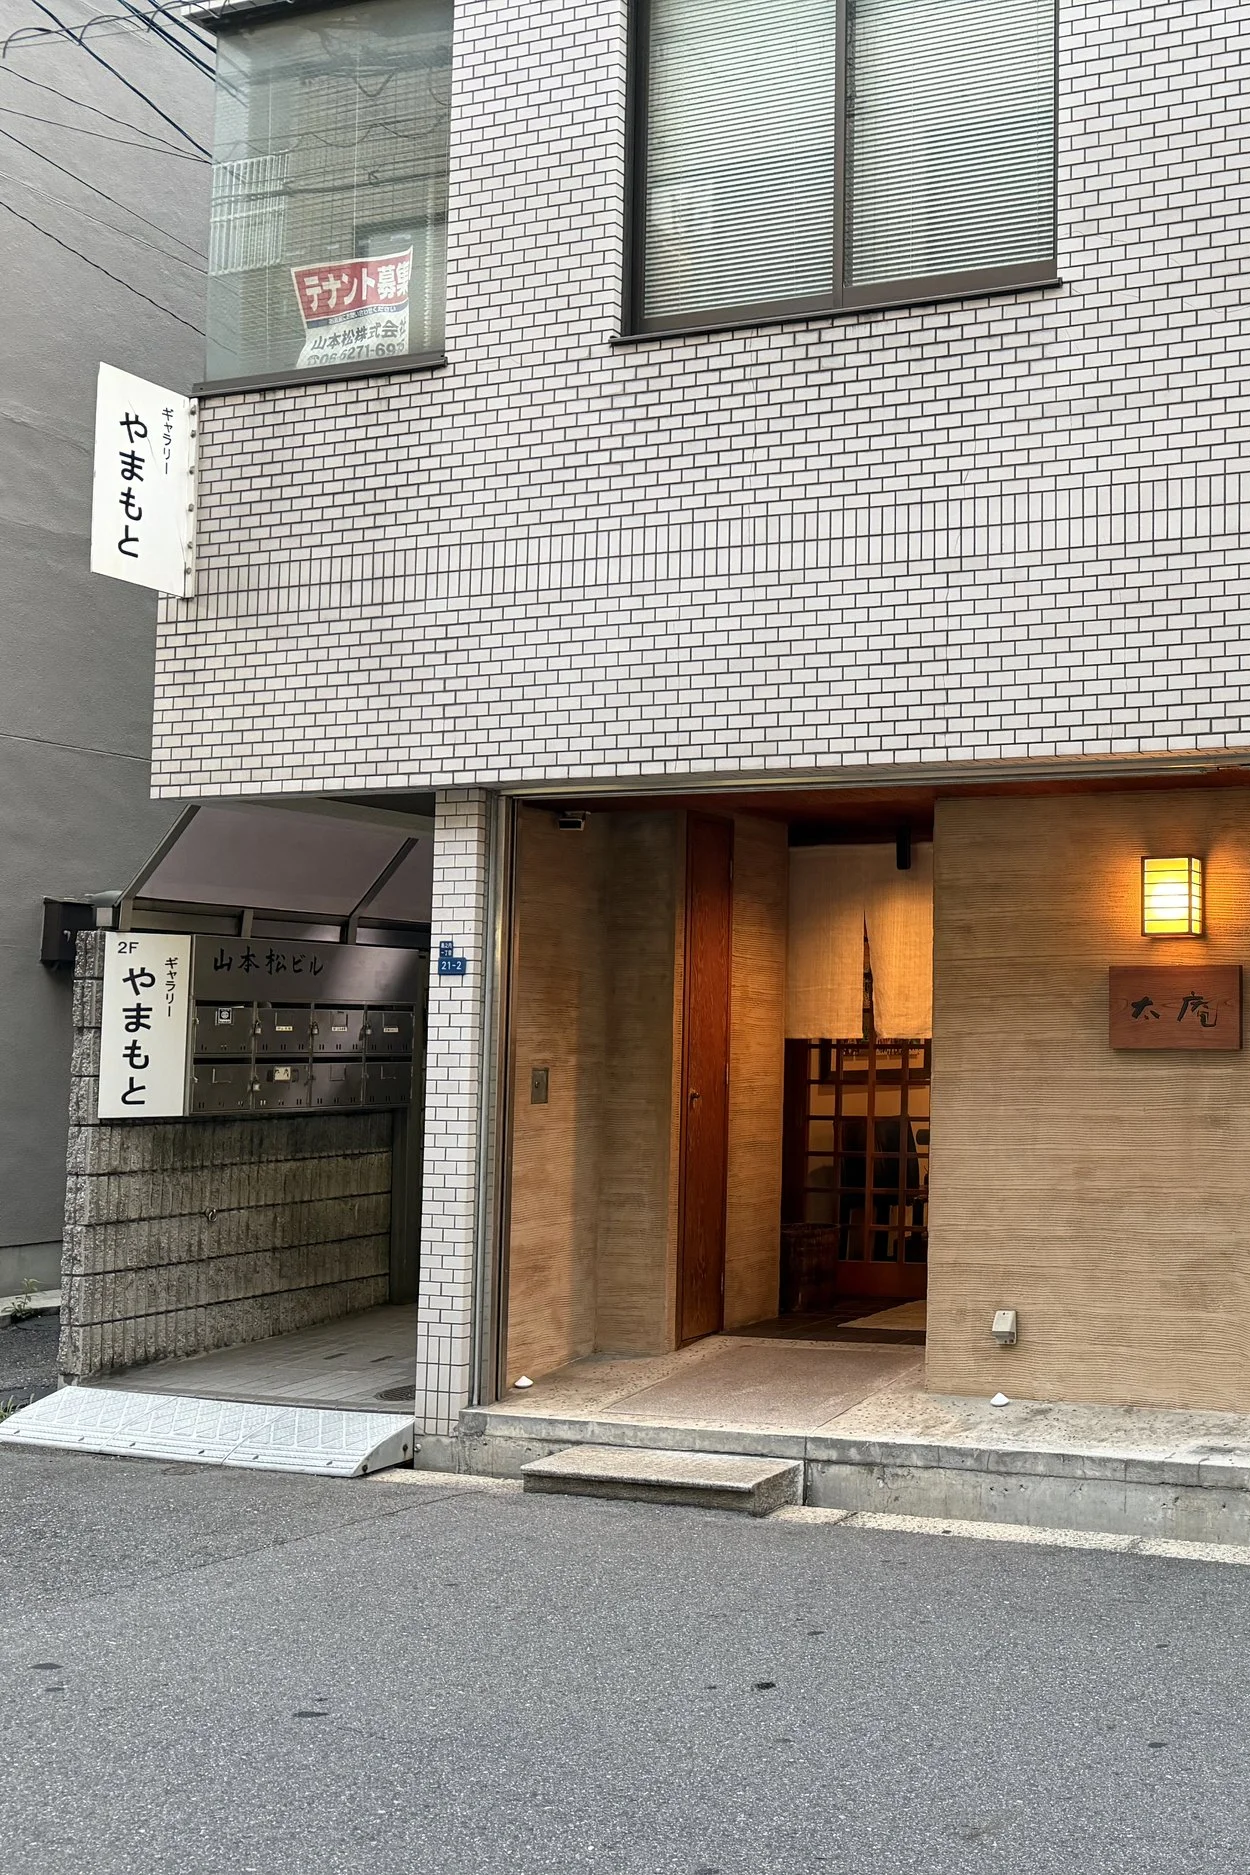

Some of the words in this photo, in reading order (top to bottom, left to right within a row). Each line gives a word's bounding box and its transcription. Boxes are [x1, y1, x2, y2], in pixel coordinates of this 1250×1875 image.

[303, 260, 410, 312] テナント募集
[162, 407, 174, 475] ギャラリー
[117, 411, 149, 559] やまもと
[117, 941, 140, 954] 2F
[213, 946, 324, 977] 山本松ビル
[441, 960, 463, 970] 21-2
[164, 957, 179, 1018] ギャラリー
[121, 966, 156, 1105] やまもと
